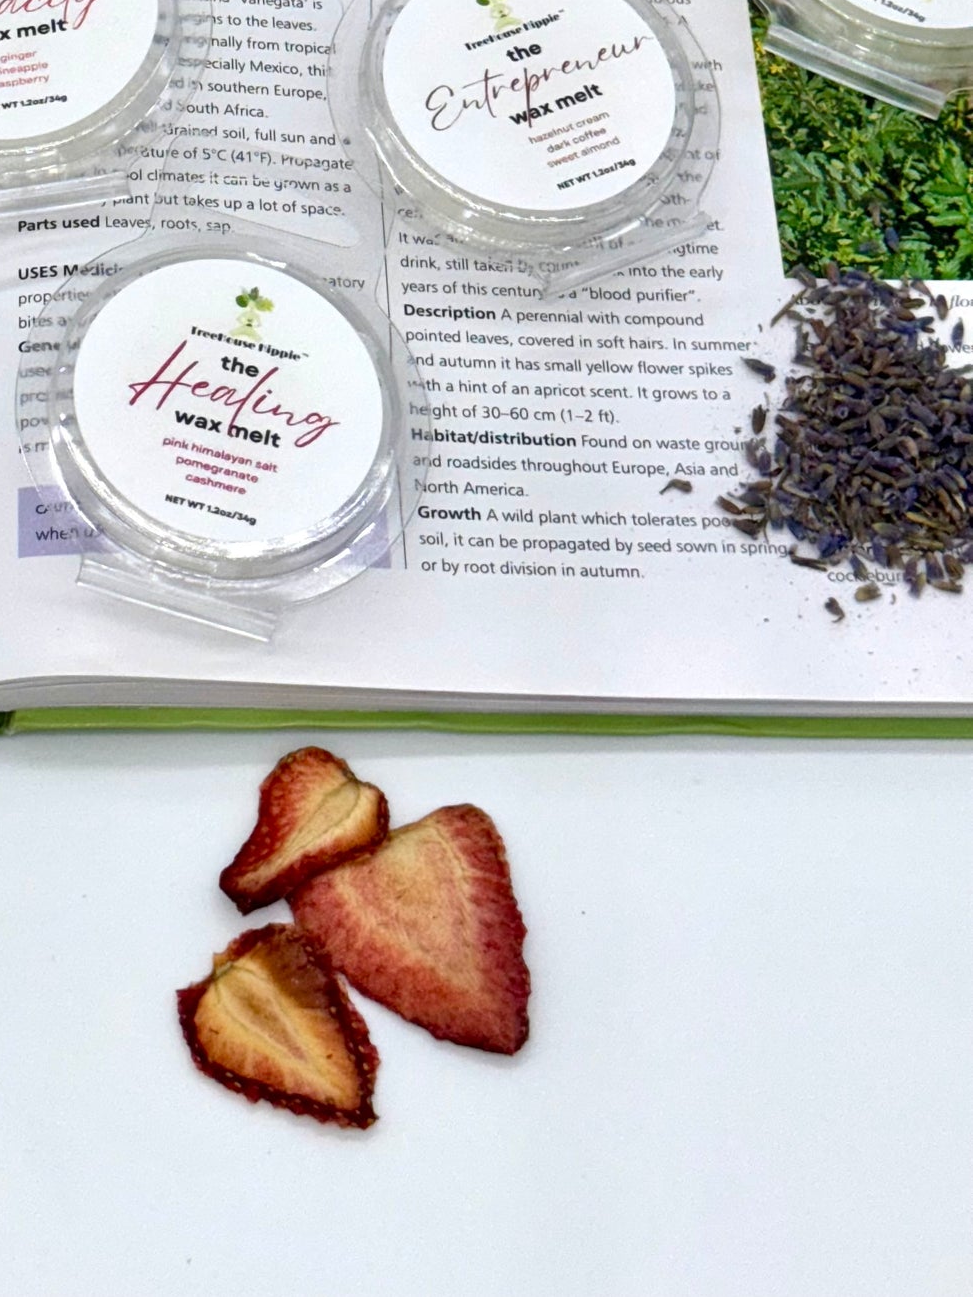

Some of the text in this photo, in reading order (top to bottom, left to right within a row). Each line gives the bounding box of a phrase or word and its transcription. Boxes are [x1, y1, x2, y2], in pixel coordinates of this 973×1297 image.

[17, 19, 67, 38] melt
[0, 51, 37, 64] ginger
[505, 42, 543, 62] the
[425, 34, 655, 132] Entrepreneur
[2, 101, 18, 110] WT
[508, 83, 603, 126] wax melt
[528, 111, 610, 145] hazelnut cream
[547, 127, 607, 154] dark coffee
[547, 138, 621, 169] sweet almond
[557, 177, 576, 191] NET
[576, 171, 592, 185] WT
[18, 215, 99, 233] Parts used
[403, 304, 496, 321] Description
[220, 355, 259, 378] the
[128, 340, 340, 448] Healing
[174, 409, 282, 449] wax melt
[411, 428, 628, 450] Habitat/distribution Found
[162, 435, 279, 474] pink himalayan salt
[175, 456, 259, 484] pomegranate
[185, 473, 247, 496] cashmere
[164, 493, 187, 507] NET
[187, 498, 205, 511] WT
[418, 506, 481, 522] Growth
[421, 558, 645, 580] or by root division in autumn.
